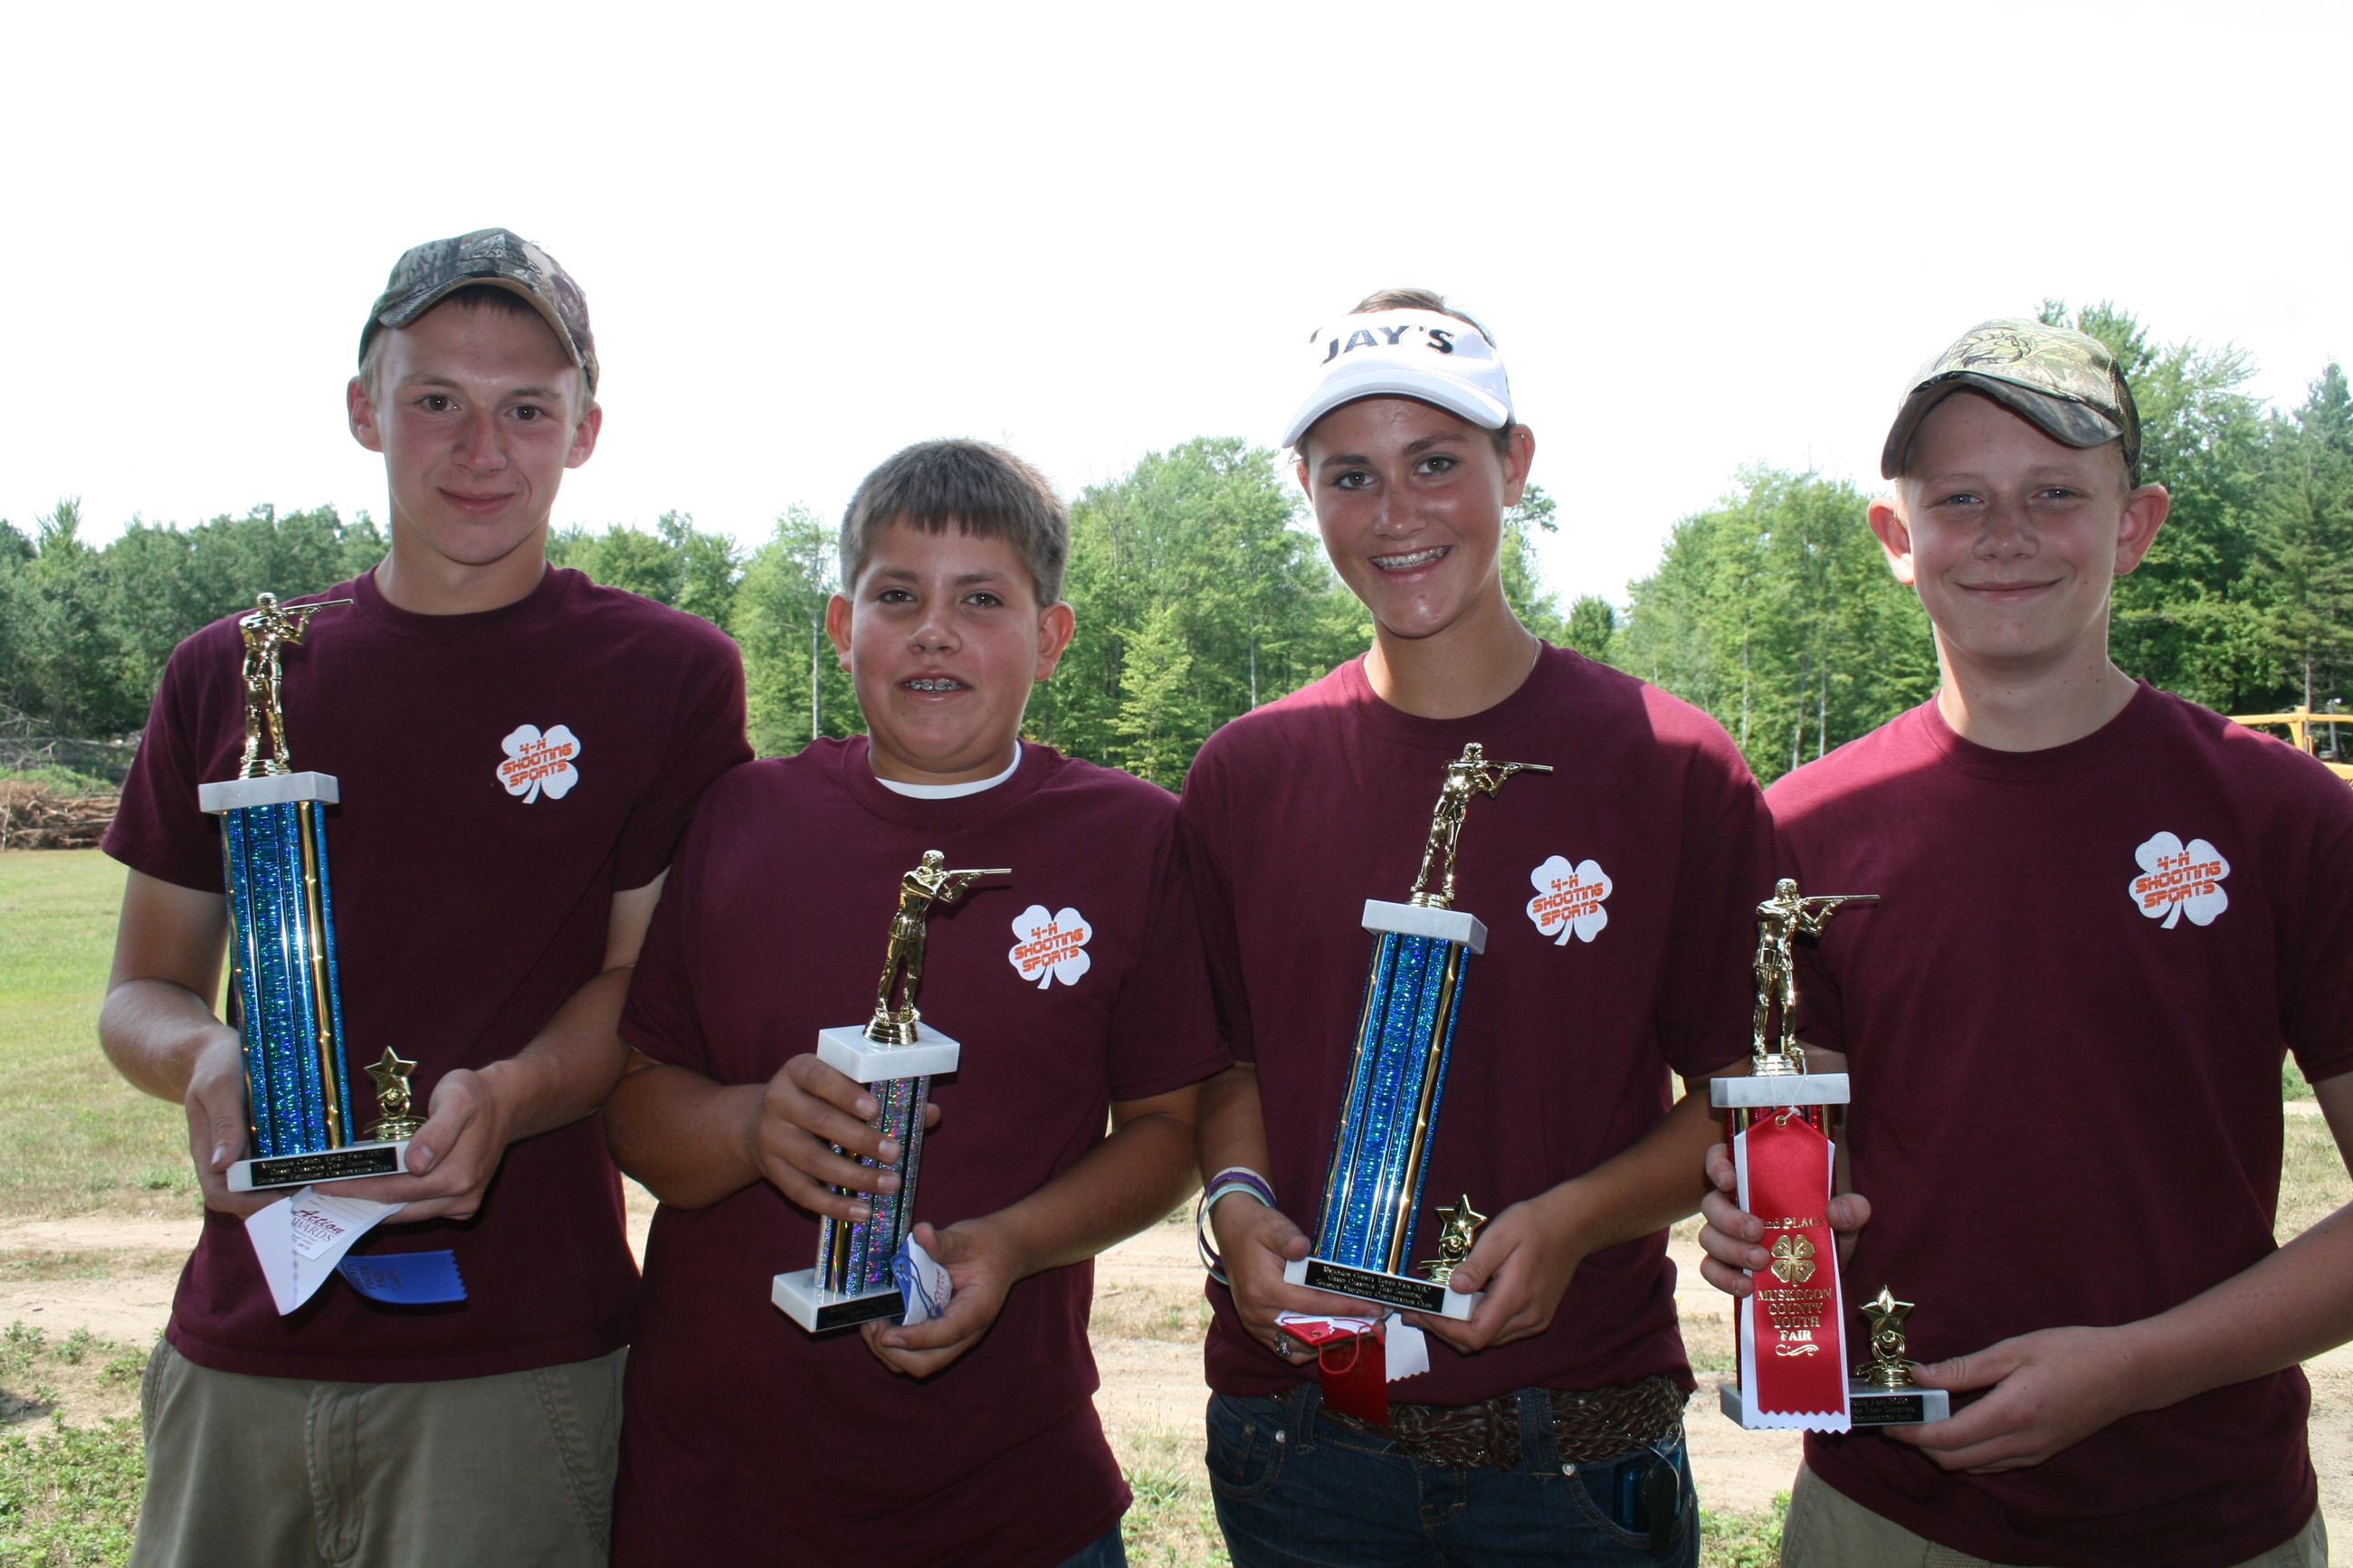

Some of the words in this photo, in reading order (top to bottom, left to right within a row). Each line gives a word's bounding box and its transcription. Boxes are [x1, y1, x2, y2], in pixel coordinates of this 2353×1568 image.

[1319, 324, 1454, 366] JAY'S
[502, 742, 573, 775] SHOOTING
[519, 738, 547, 755] 4-H
[510, 758, 568, 787] SPORTS
[2157, 851, 2190, 870] 4-H
[1550, 873, 1579, 891] 4-H
[2136, 860, 2222, 894] SHOOTING
[1532, 882, 1604, 914] SHOOTING
[2144, 879, 2215, 908] SPORTS
[1540, 899, 1599, 927] SPORTS
[1014, 927, 1084, 960] SHOOTING
[1031, 921, 1058, 939] 4-H
[1022, 944, 1080, 973] SPORTS
[293, 1209, 346, 1234] Action
[1768, 1303, 1824, 1316] COUNTY
[1772, 1316, 1821, 1328] YOUTH
[1779, 1329, 1813, 1342] FAIR
